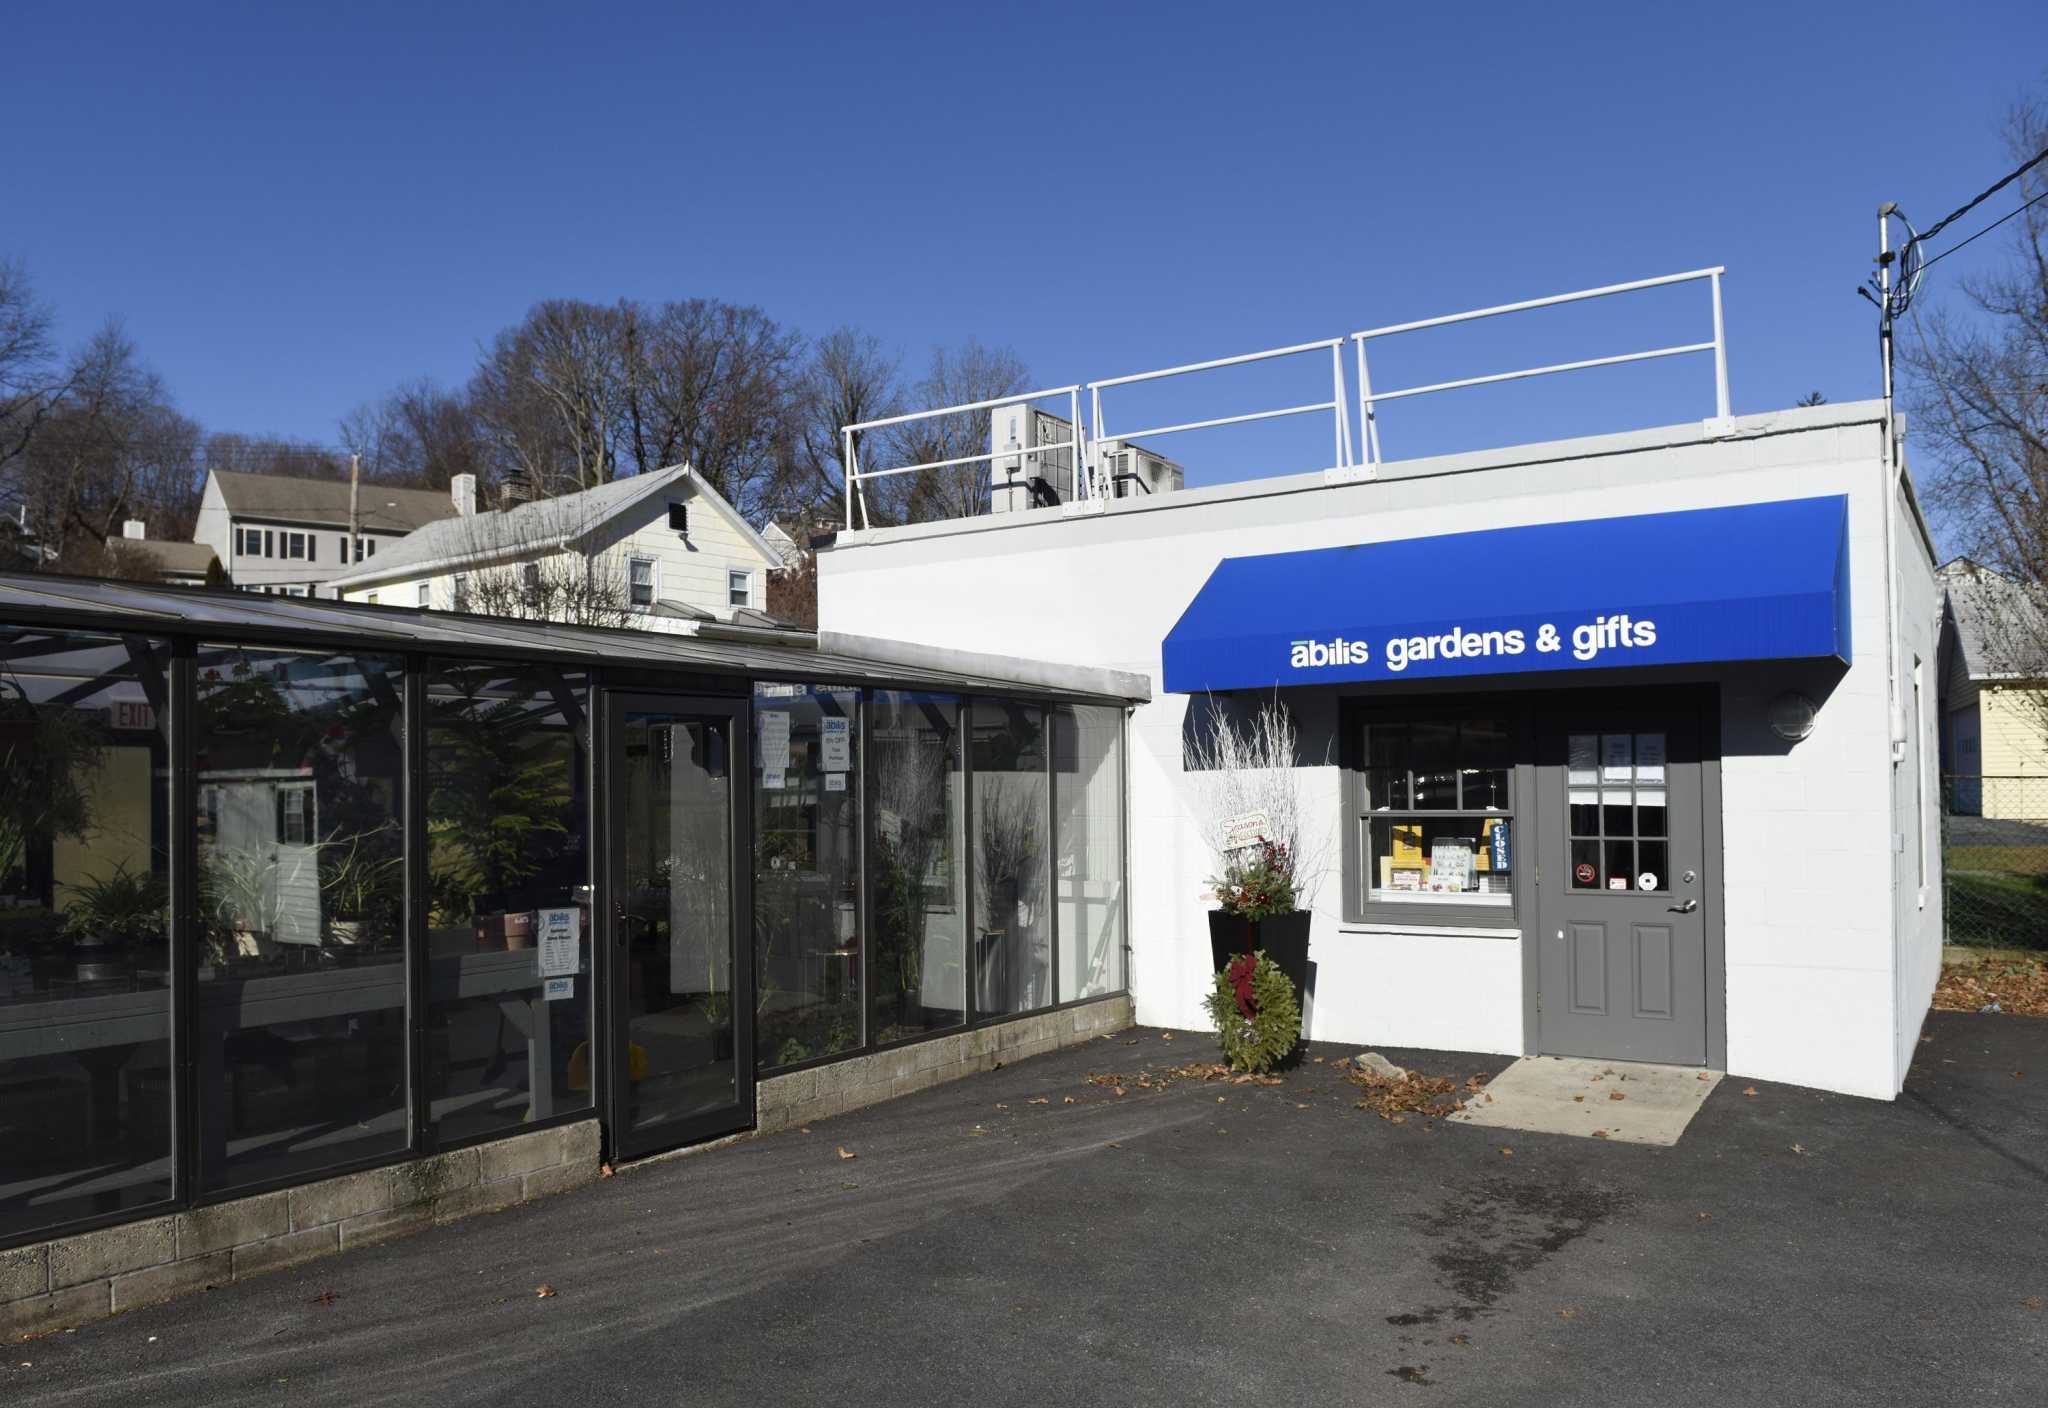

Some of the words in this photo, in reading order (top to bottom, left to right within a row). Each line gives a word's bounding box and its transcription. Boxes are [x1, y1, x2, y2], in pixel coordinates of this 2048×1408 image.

[1386, 626, 1526, 671] gardens
[1536, 623, 1561, 652] &
[1572, 614, 1656, 660] gifts
[120, 703, 151, 727] EXIT
[1493, 825, 1508, 870] CLOSED
